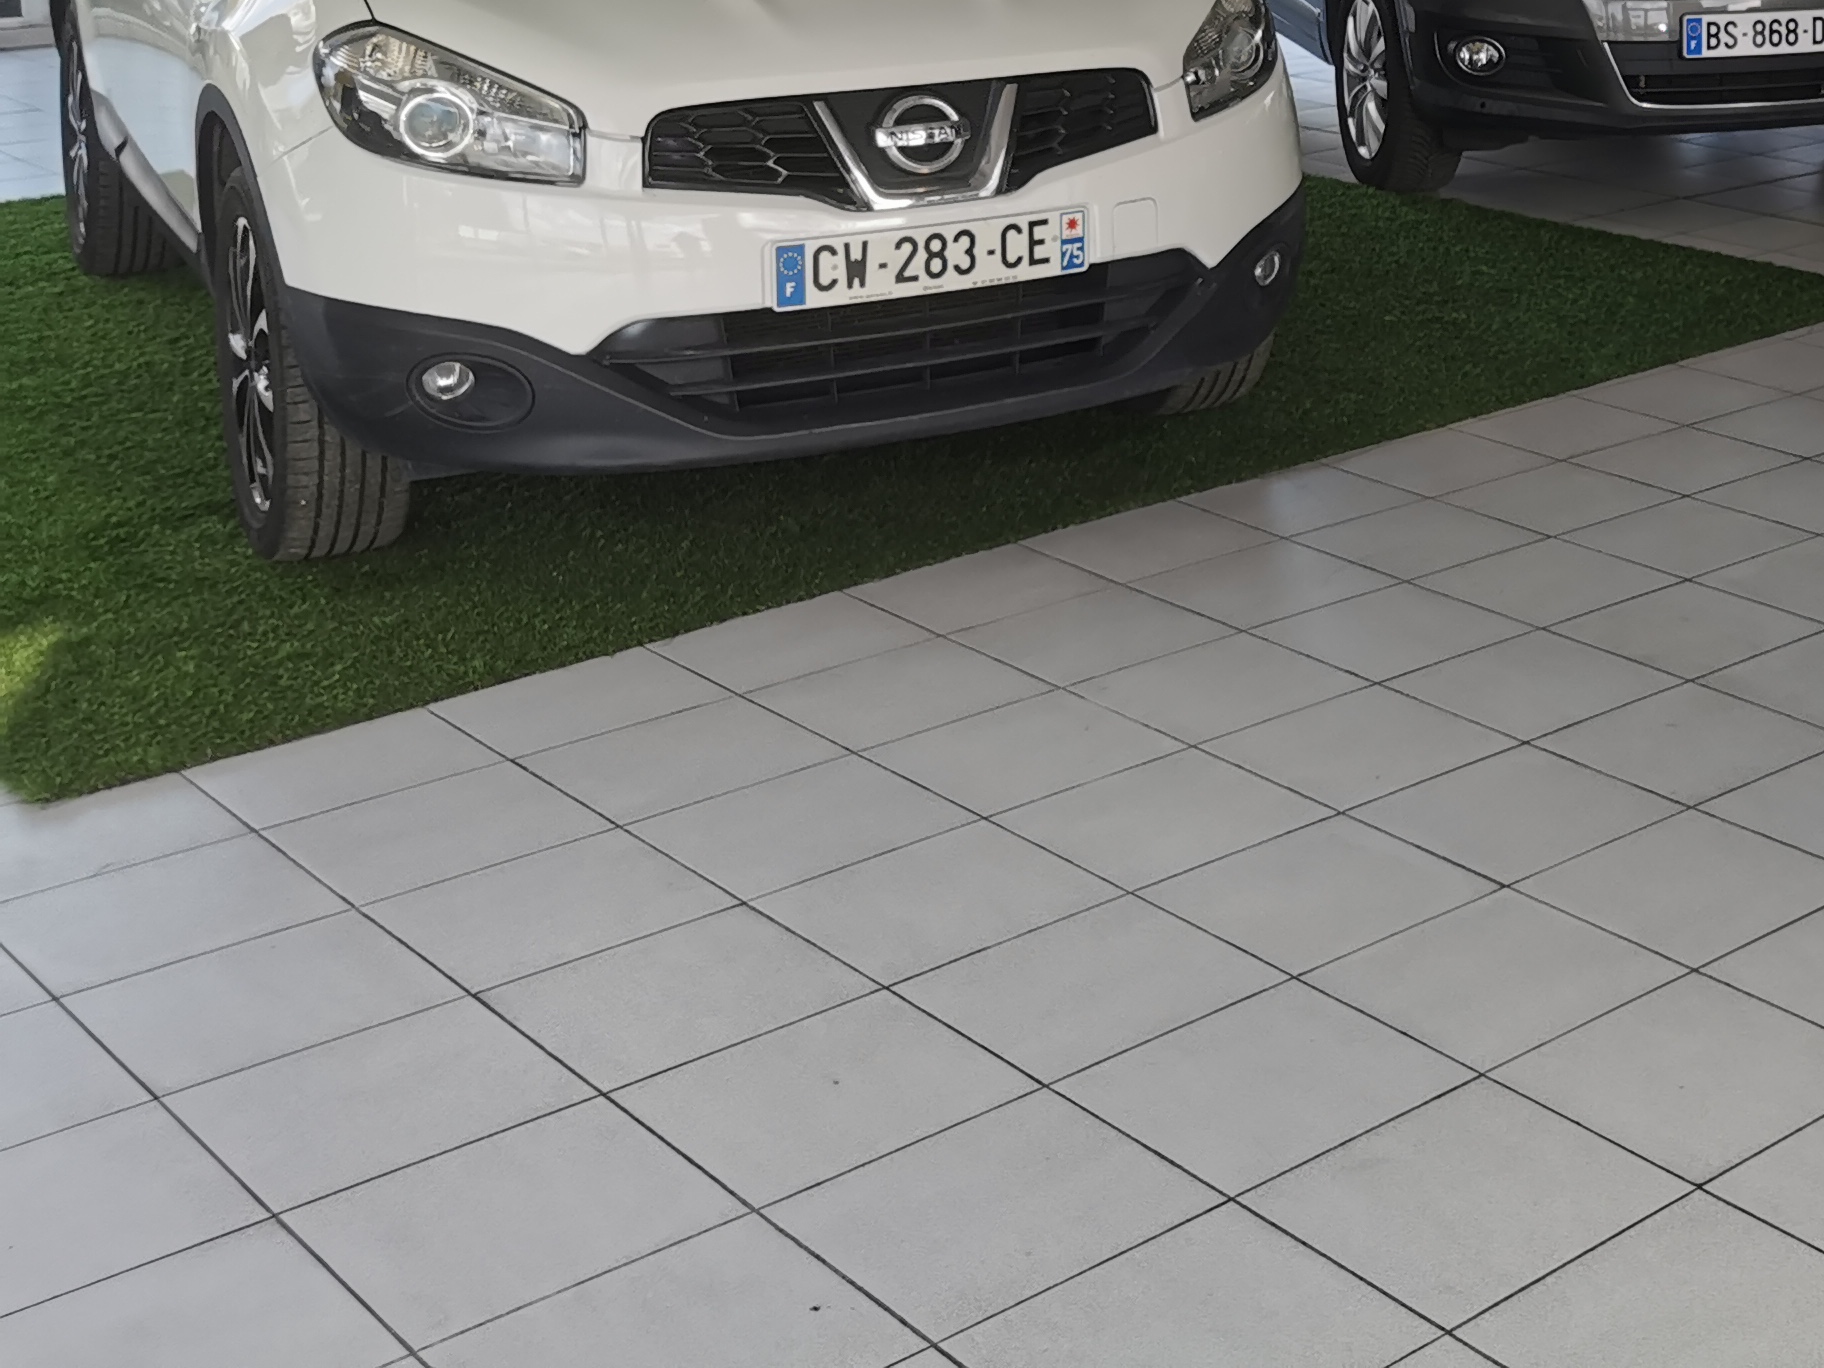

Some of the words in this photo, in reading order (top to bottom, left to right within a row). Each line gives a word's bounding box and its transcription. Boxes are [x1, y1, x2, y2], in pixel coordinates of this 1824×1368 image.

[812, 218, 1050, 292] CW-283-CE
[1062, 242, 1084, 268] 75
[785, 281, 796, 298] F
